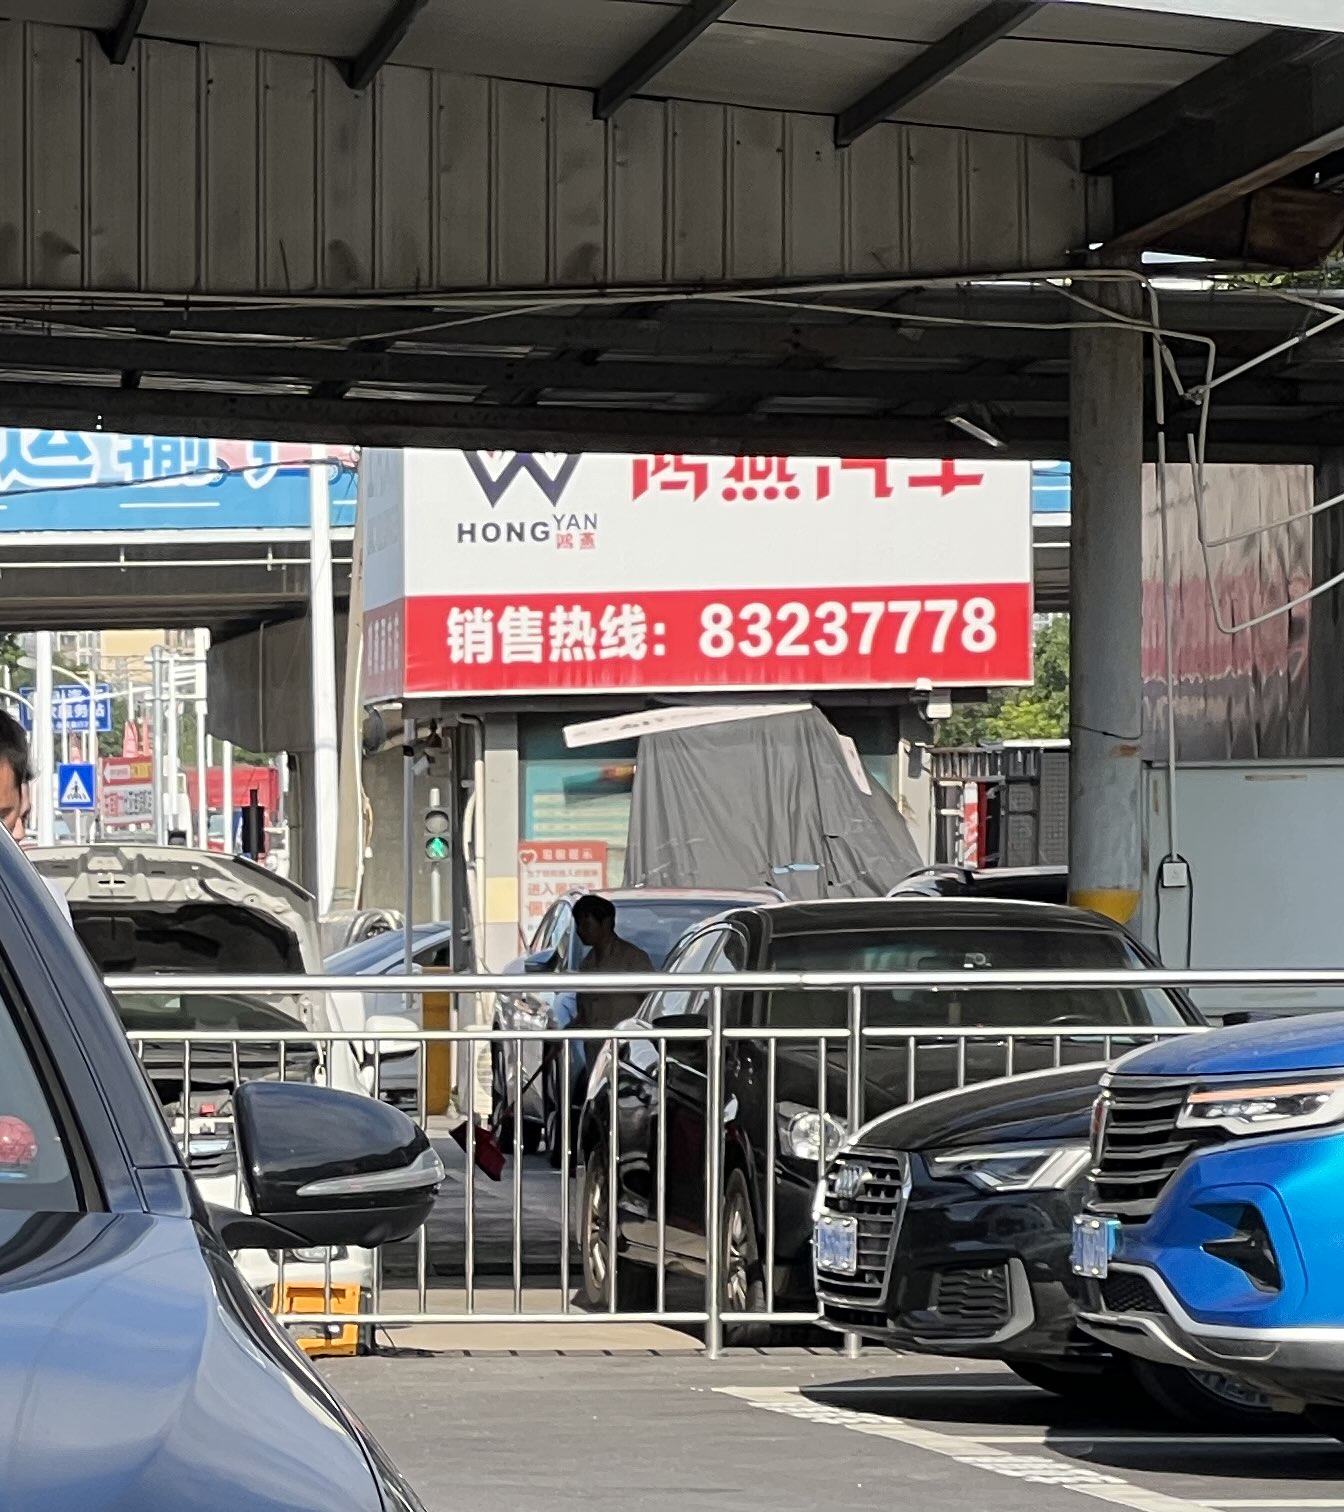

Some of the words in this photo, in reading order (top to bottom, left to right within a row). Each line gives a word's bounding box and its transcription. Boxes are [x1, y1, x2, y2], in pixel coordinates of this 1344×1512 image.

[457, 521, 550, 544] HONG
[552, 513, 598, 531] YAN
[699, 597, 997, 658] 83237778
